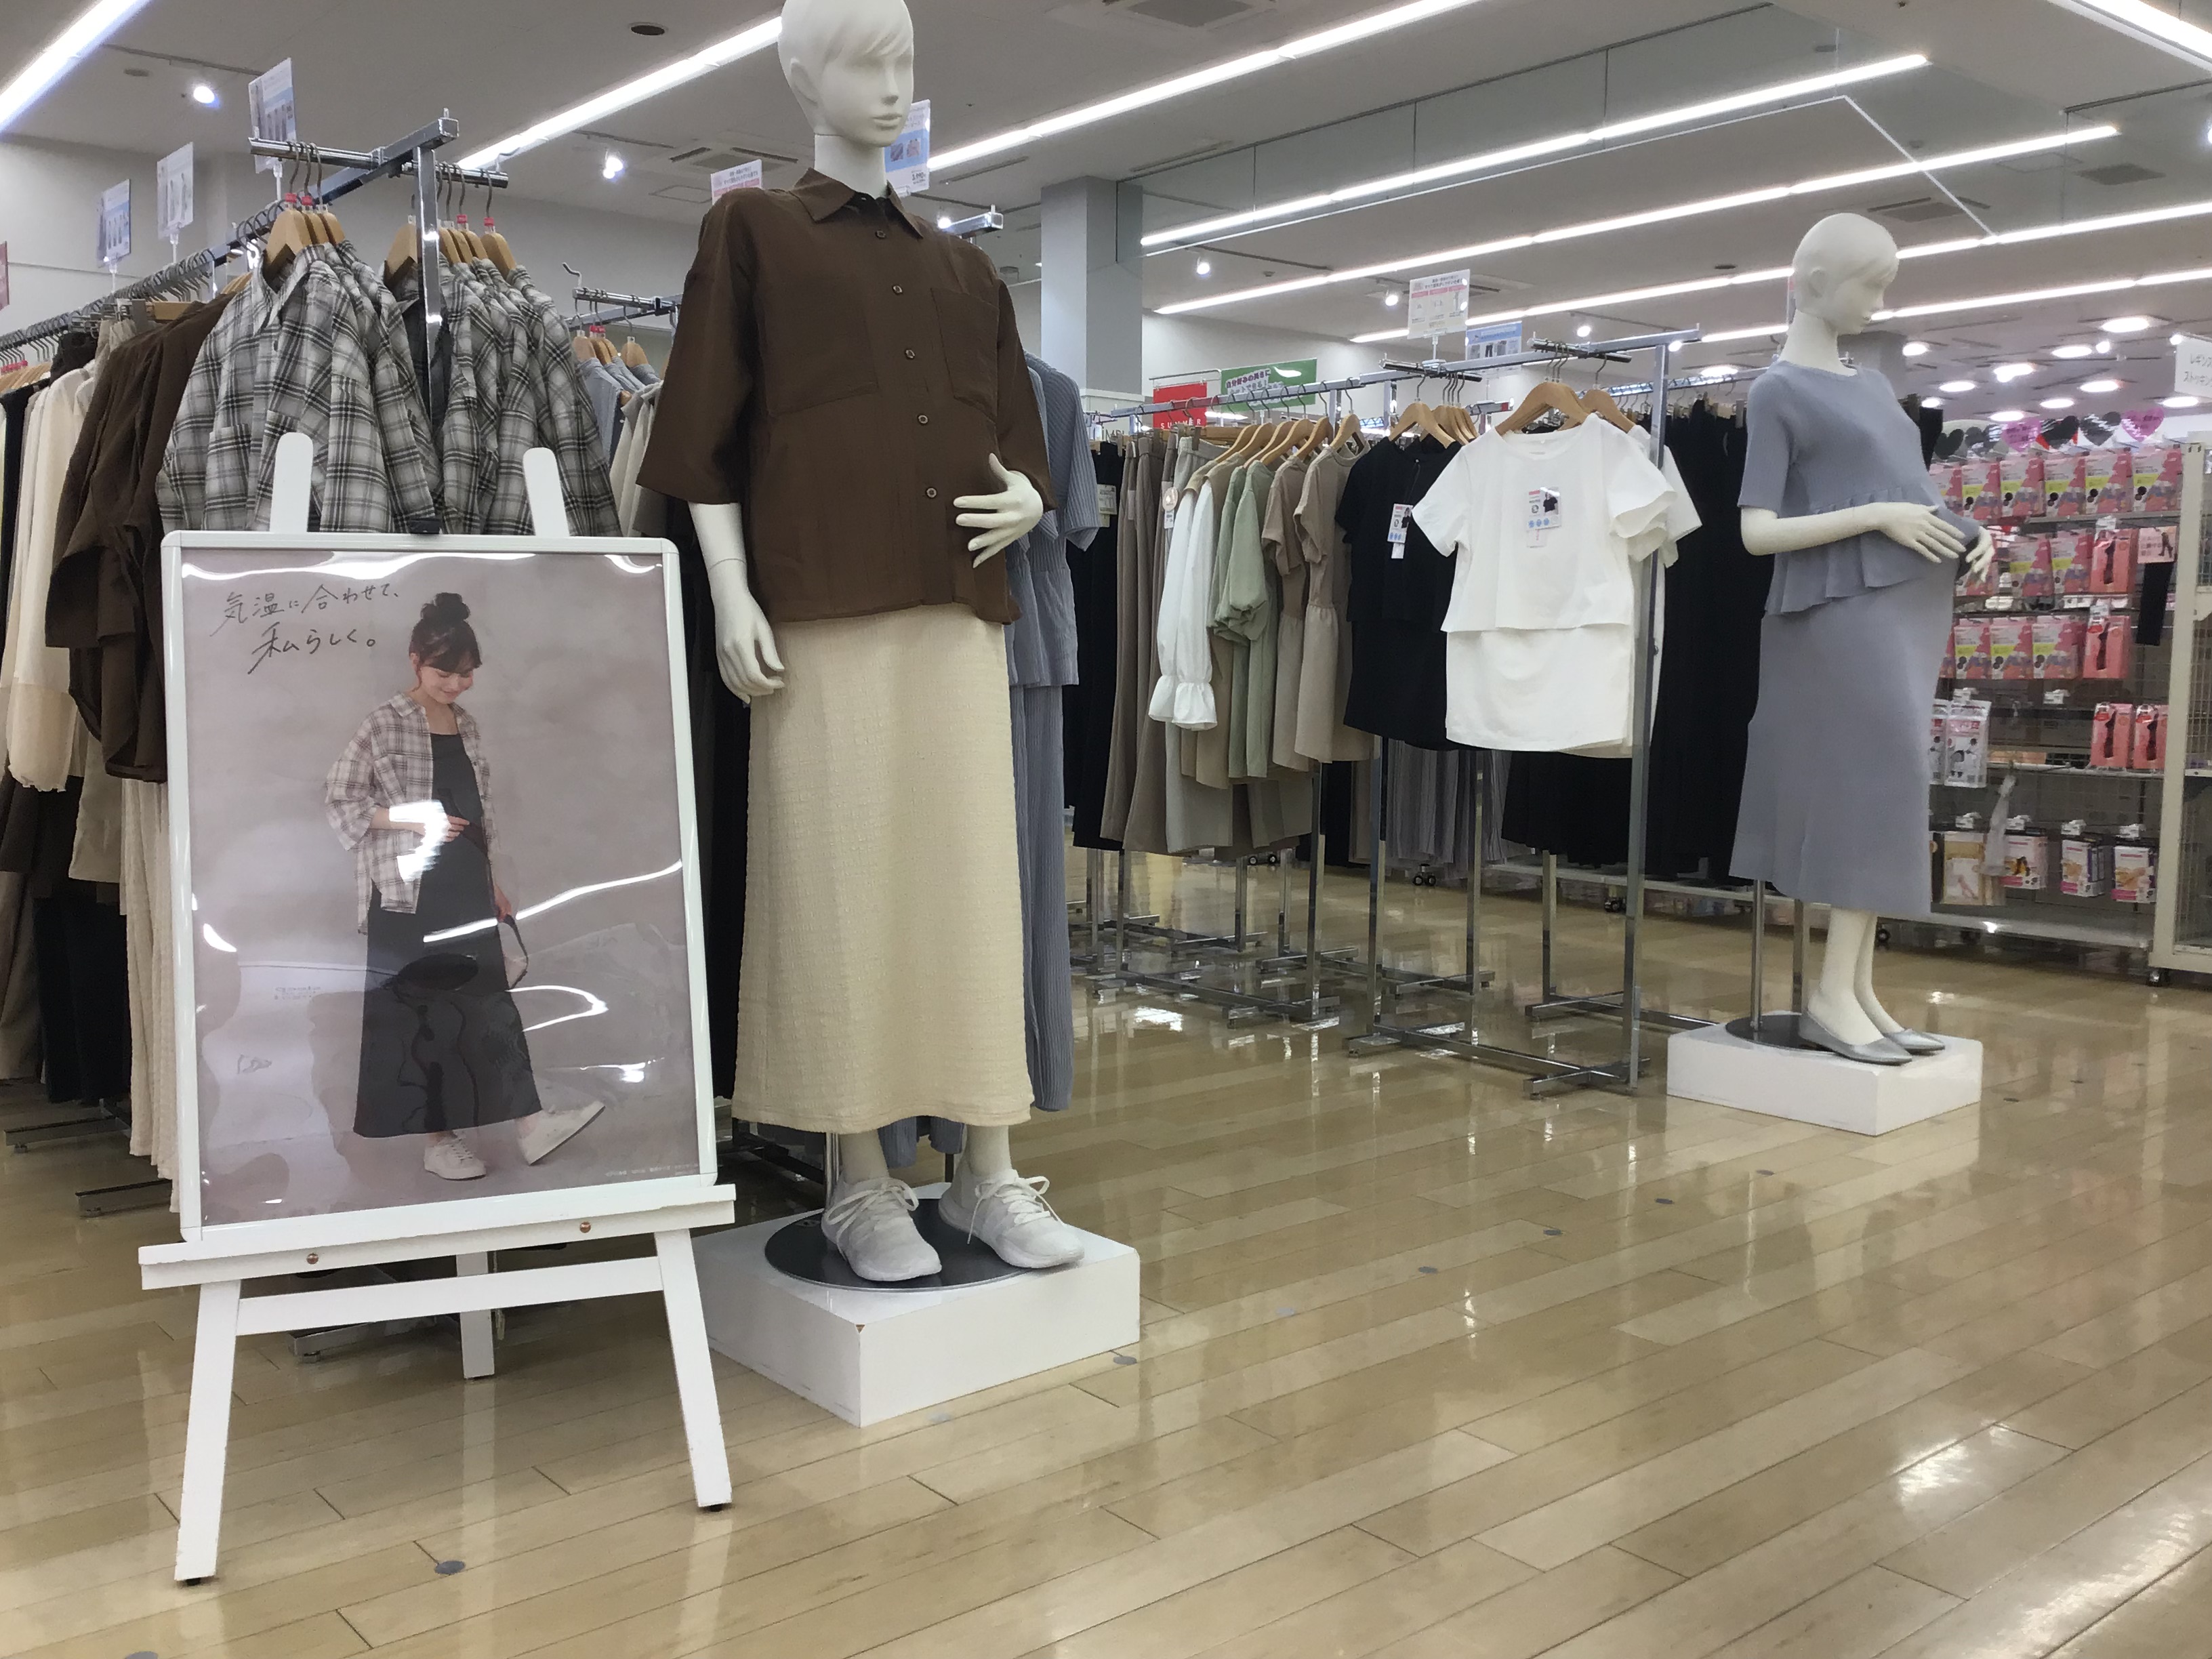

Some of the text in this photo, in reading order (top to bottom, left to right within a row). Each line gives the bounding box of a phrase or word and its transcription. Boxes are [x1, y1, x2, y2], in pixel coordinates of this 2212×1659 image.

[2183, 371, 2212, 388] ストッキン
[209, 583, 398, 637] 気温に合わせて、
[247, 621, 376, 675] 私らしく。
